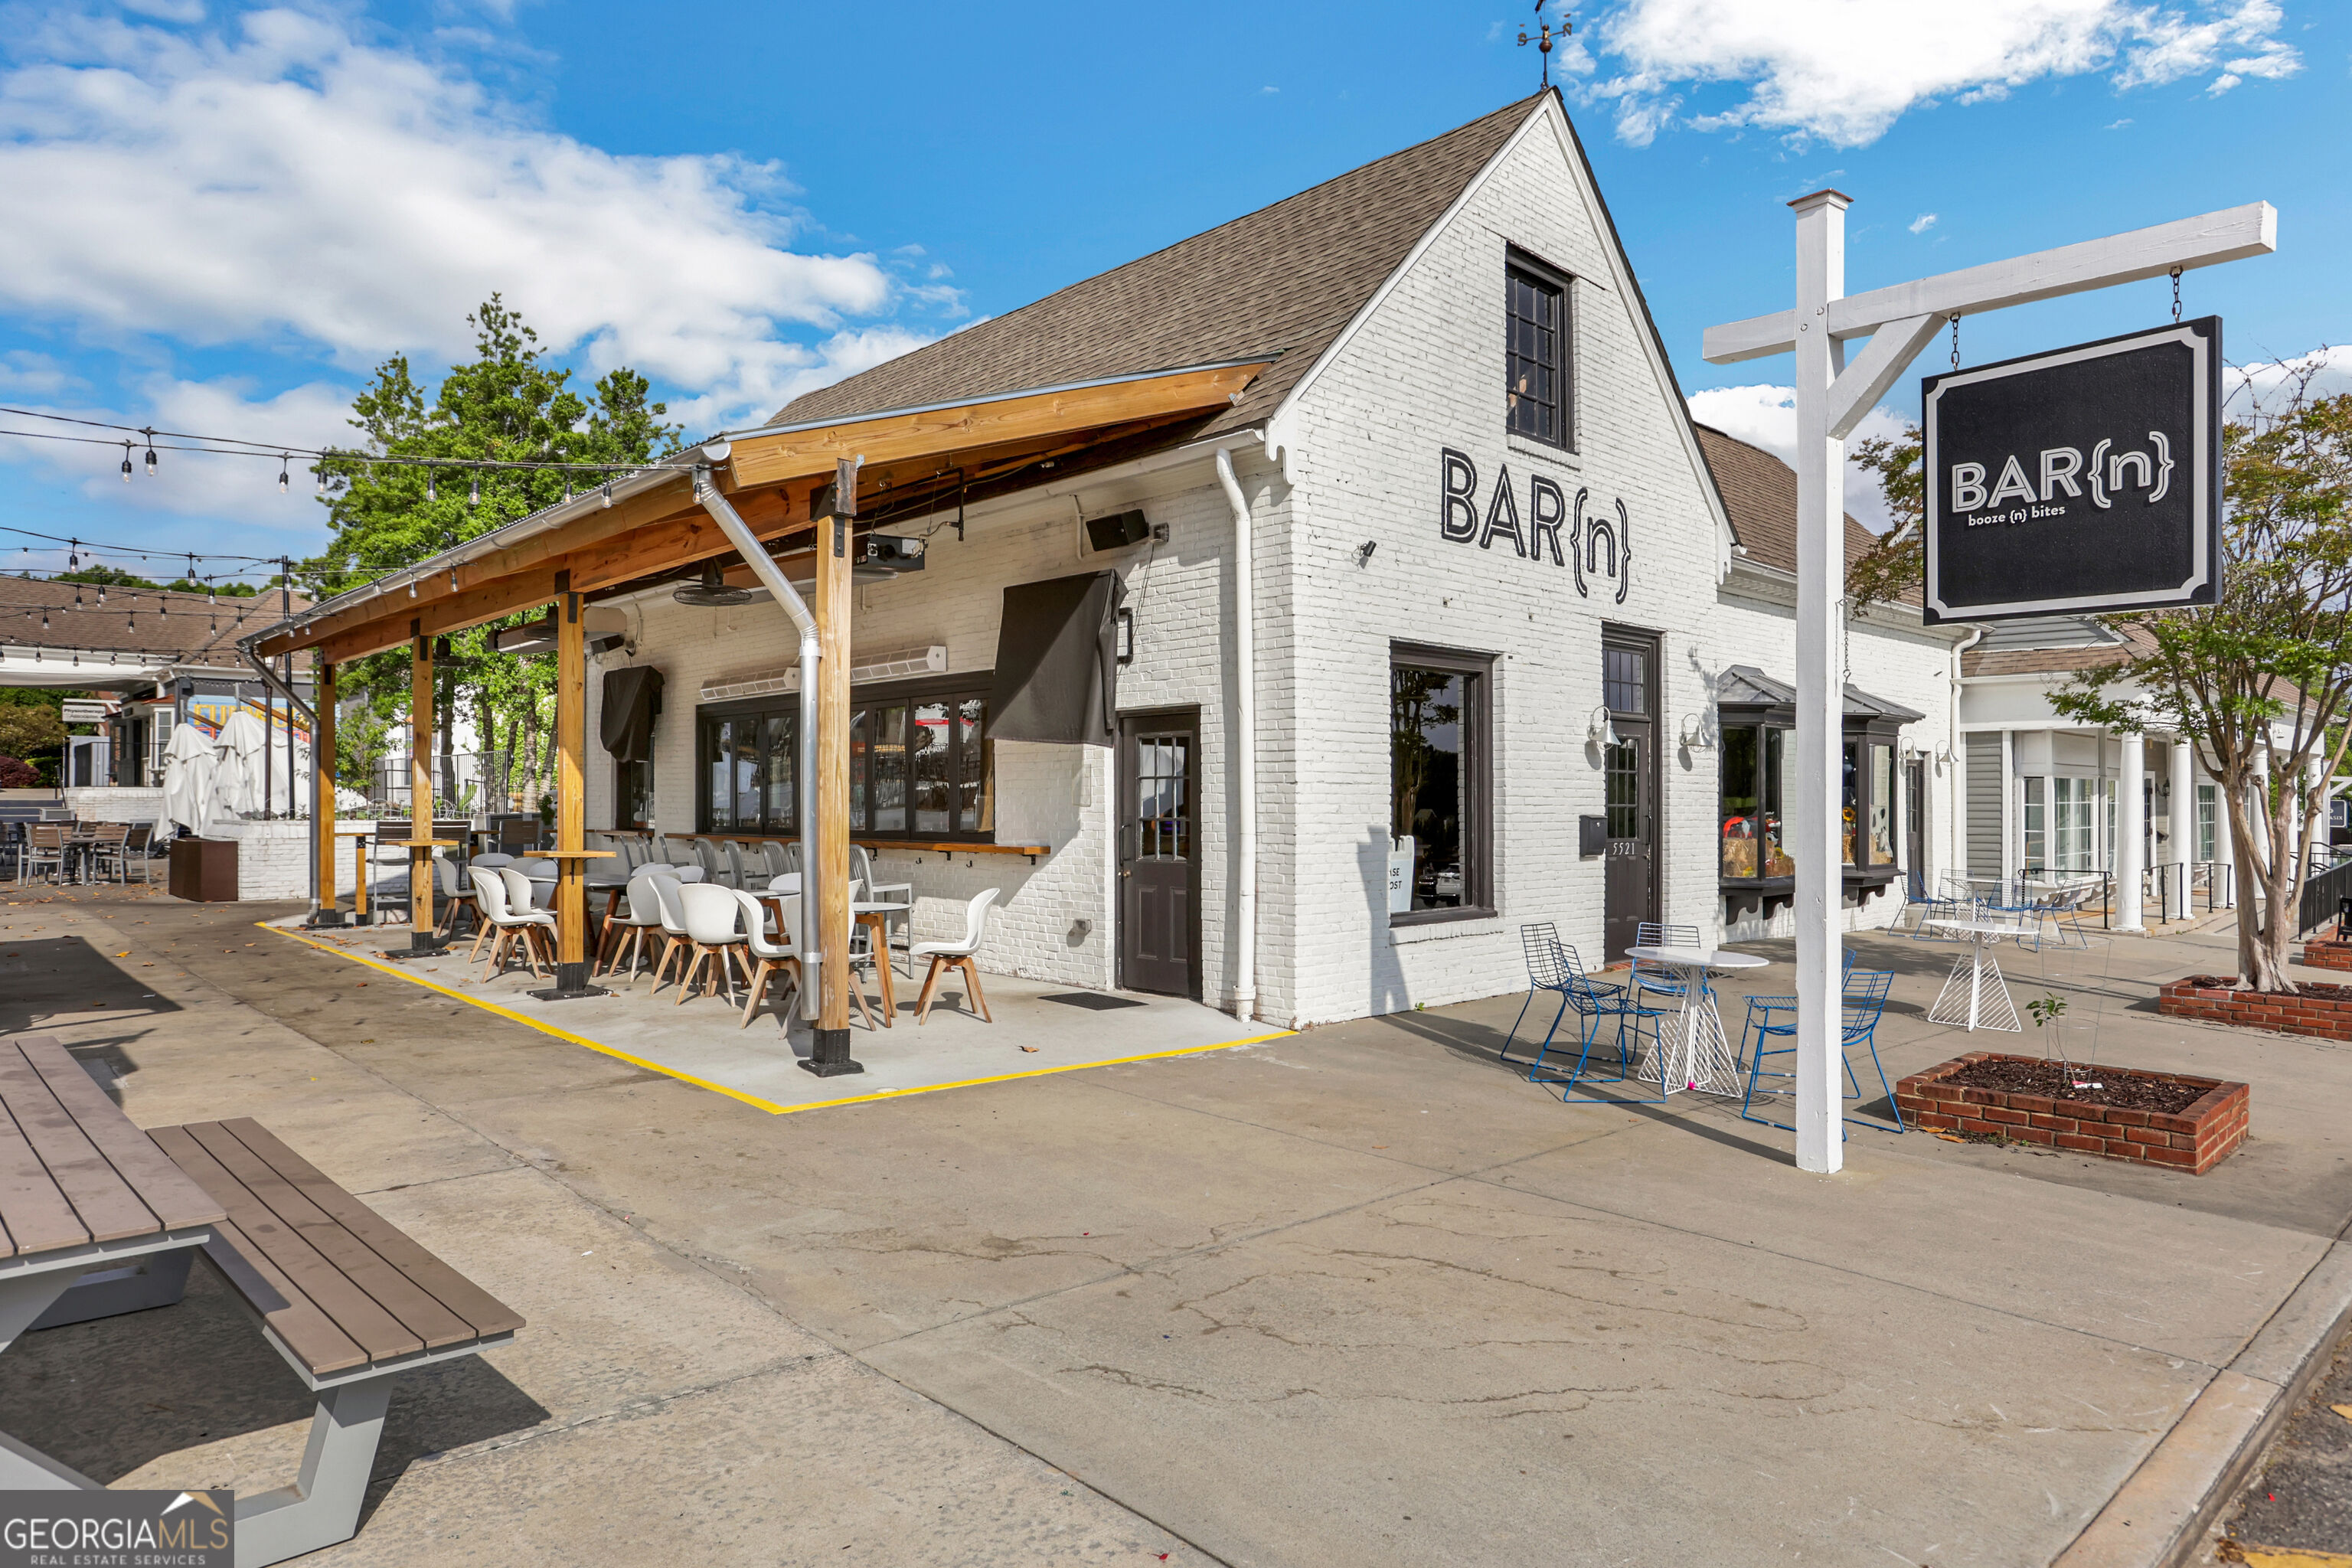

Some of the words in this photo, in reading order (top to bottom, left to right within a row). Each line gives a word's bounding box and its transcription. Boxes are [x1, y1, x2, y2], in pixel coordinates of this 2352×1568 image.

[1952, 431, 2174, 514] BAR{n}
[1441, 447, 1632, 605] BAR{n}
[1968, 514, 2006, 526] booze
[2010, 509, 2027, 524] {n}
[2031, 505, 2066, 518] bites
[1612, 842, 1635, 855] 5521
